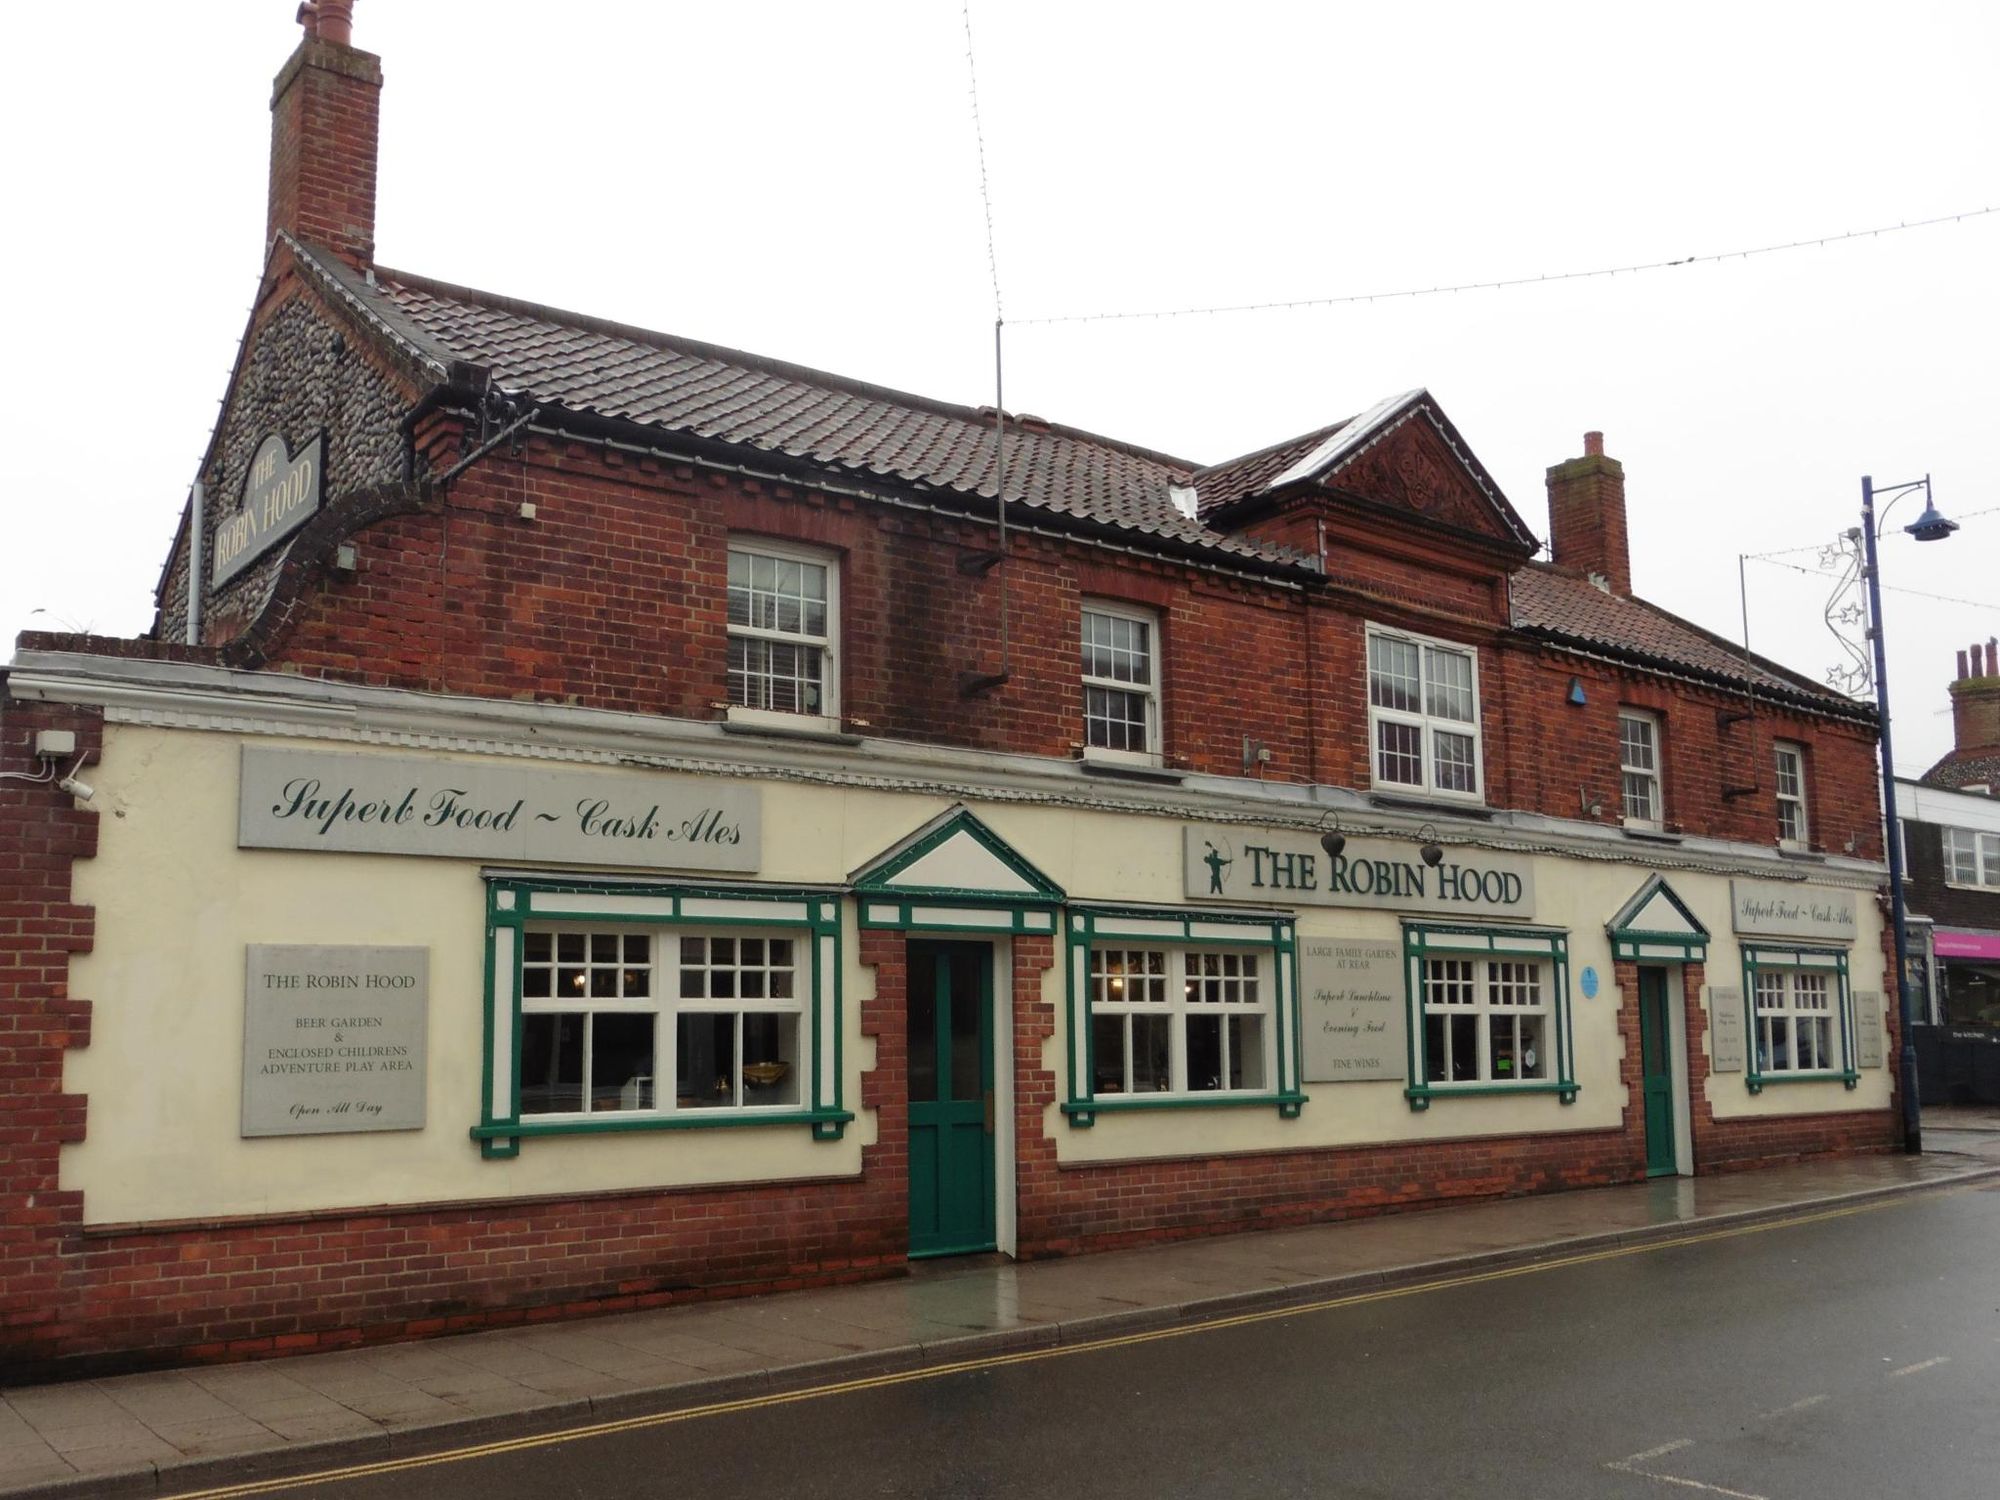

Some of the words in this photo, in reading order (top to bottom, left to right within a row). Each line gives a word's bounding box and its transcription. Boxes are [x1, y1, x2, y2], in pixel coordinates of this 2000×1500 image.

[254, 449, 277, 489] THE
[217, 508, 258, 570] ROBIN
[263, 459, 313, 532] HOOD
[271, 778, 418, 835] Superb
[423, 788, 525, 832] Food
[575, 798, 660, 839] Cask
[666, 808, 742, 846] Ales
[1244, 844, 1318, 891] THE
[1329, 854, 1426, 898] ROBIN
[1437, 863, 1523, 905] HOOD
[1306, 946, 1332, 957] LARGE
[1335, 947, 1362, 958] FAMILY
[1365, 949, 1397, 959] GARDEN
[1337, 960, 1346, 969] AT
[1349, 960, 1370, 969] REAR
[263, 974, 301, 990] THE
[306, 974, 360, 989] ROBIN
[365, 974, 416, 989] HOOD
[295, 1017, 326, 1029] BEER
[330, 1016, 383, 1029] GARDEN
[1323, 1020, 1359, 1038] Evening
[334, 1031, 344, 1043] &
[268, 1047, 334, 1060] ENCLOSED
[260, 1062, 341, 1075] ADVENTURE
[345, 1061, 375, 1073] PLAY
[379, 1060, 414, 1072] AREA
[1333, 1059, 1351, 1069] FINE
[1354, 1059, 1380, 1069] WINES
[289, 1103, 320, 1120] Open
[327, 1101, 351, 1114] All
[355, 1101, 383, 1116] Day
